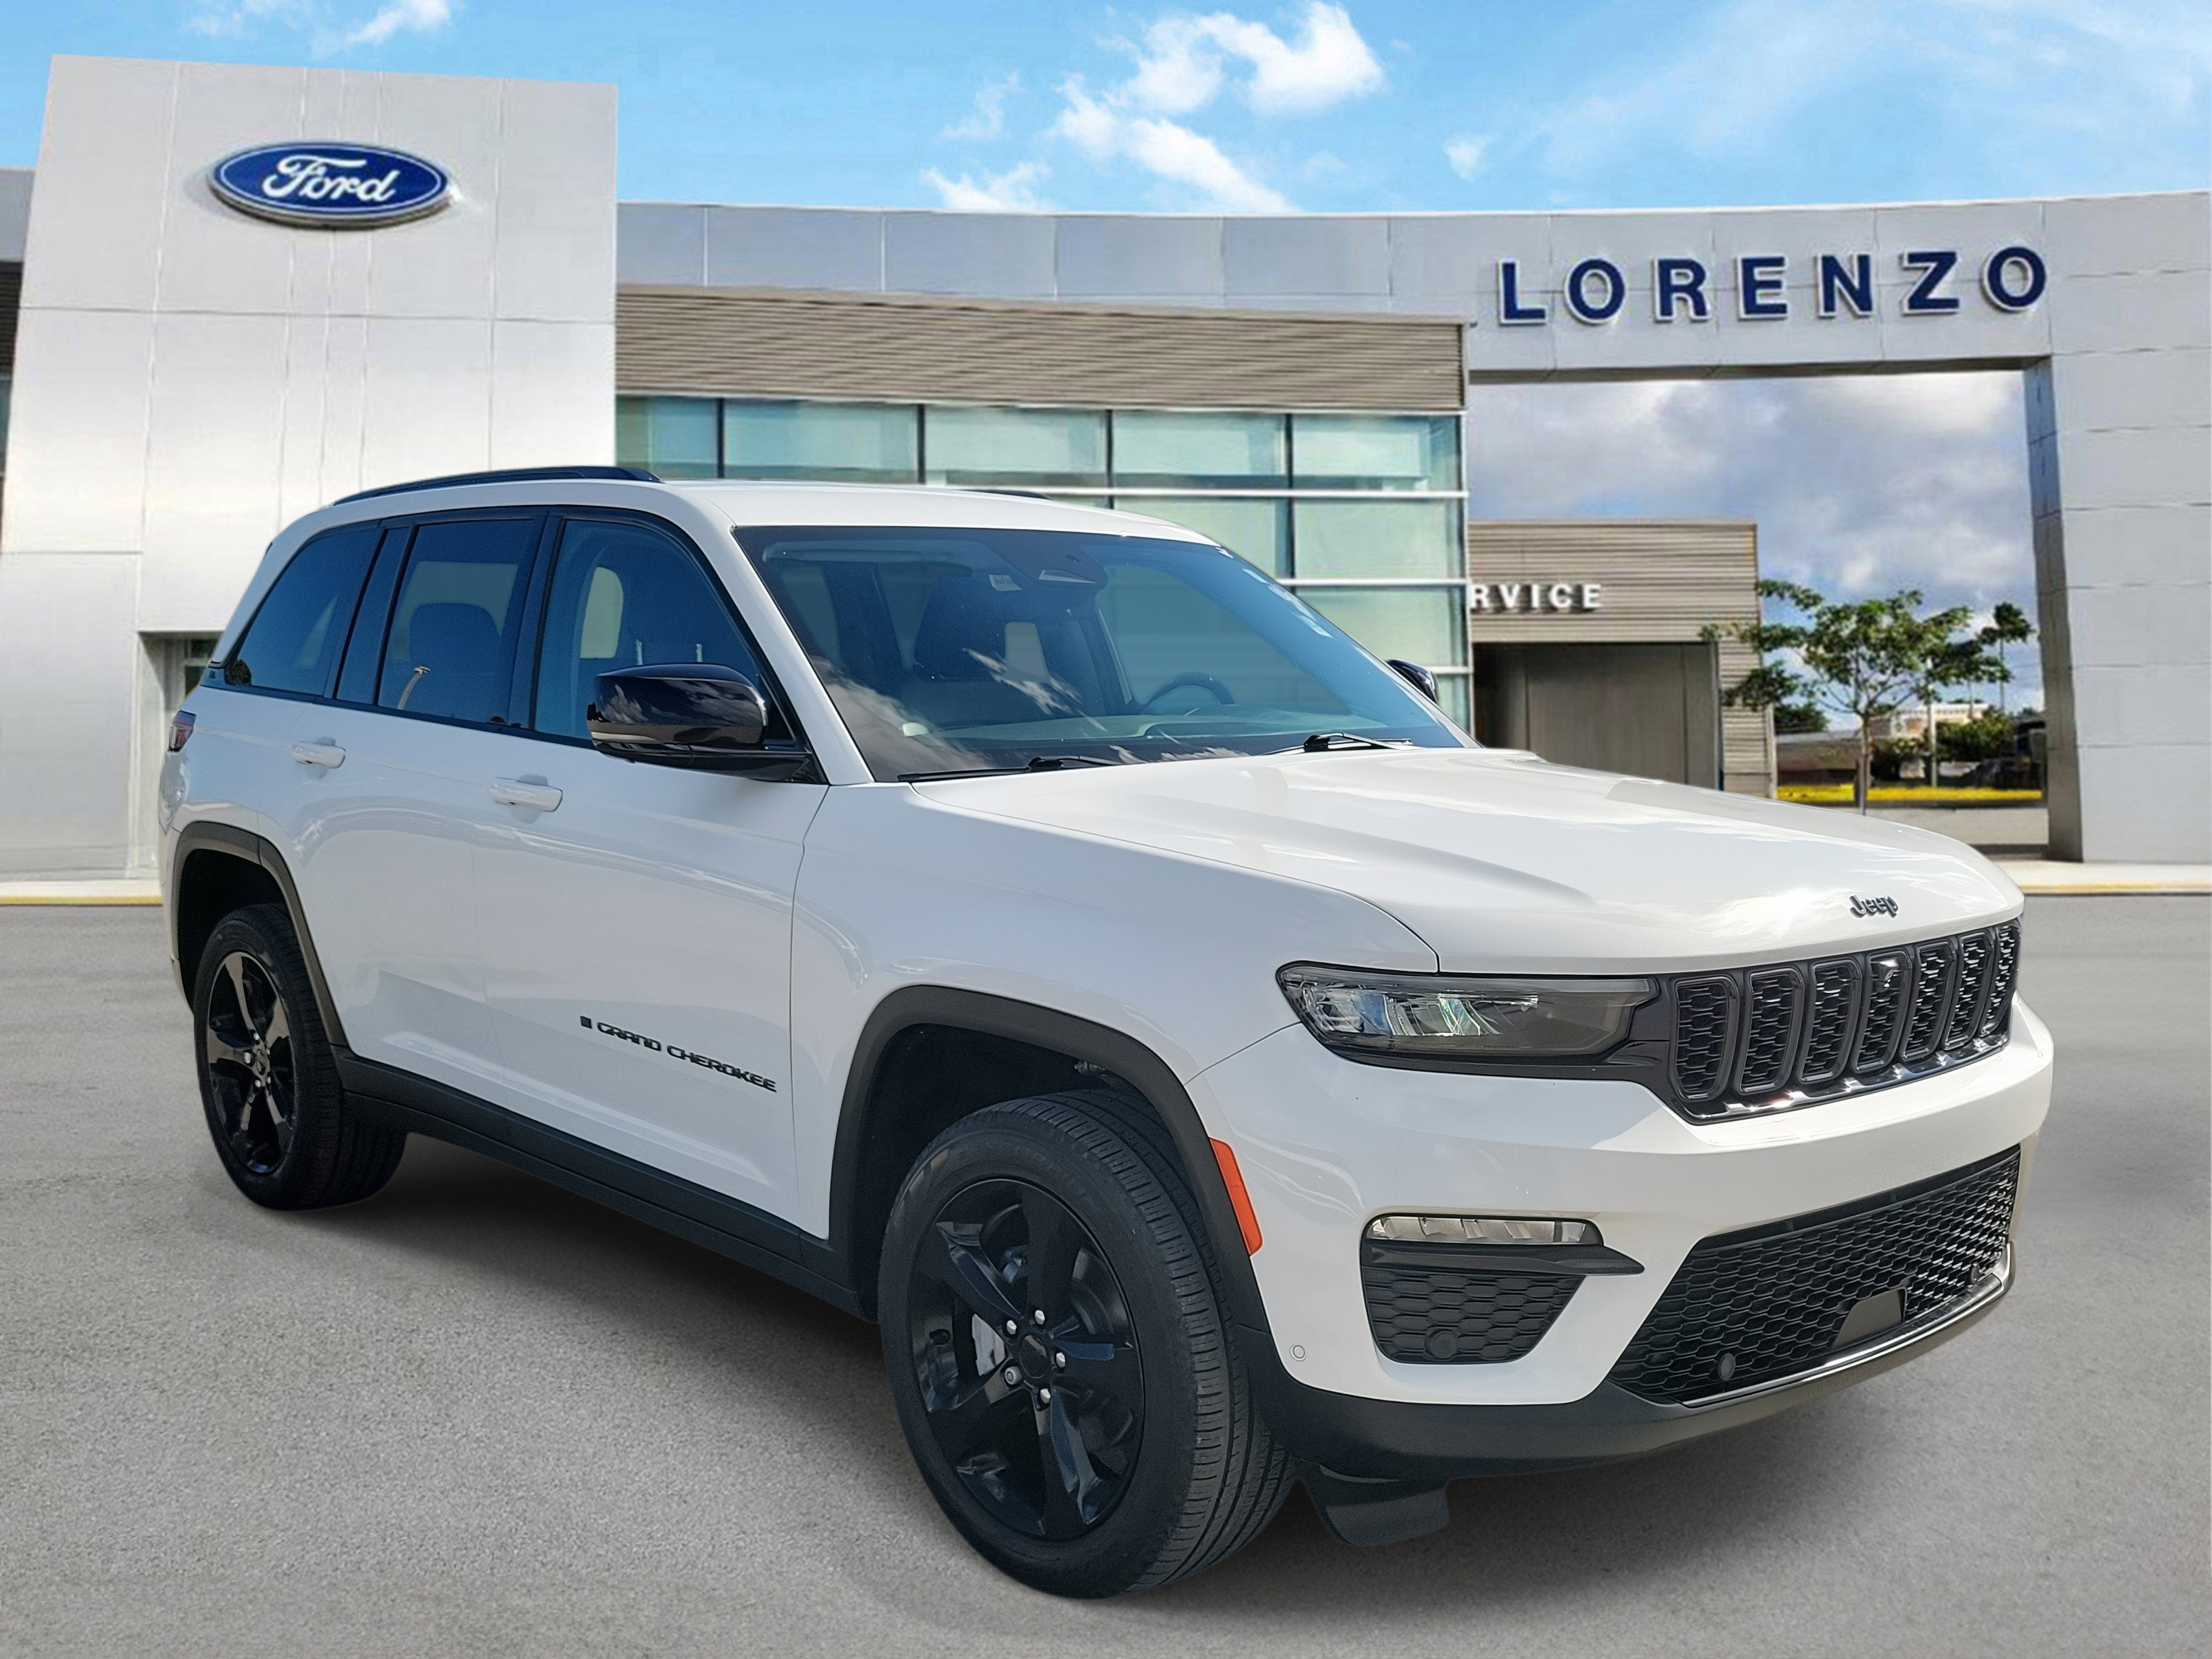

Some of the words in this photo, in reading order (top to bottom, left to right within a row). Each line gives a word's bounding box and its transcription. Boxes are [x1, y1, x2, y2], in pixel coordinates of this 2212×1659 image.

[262, 154, 400, 202] Ford
[1499, 246, 2046, 322] LORENZO
[1470, 584, 1601, 609] RVICE
[1850, 895, 1899, 918] Jeep
[597, 1022, 662, 1051] GRAND
[666, 1045, 777, 1093] CHEROKEE
